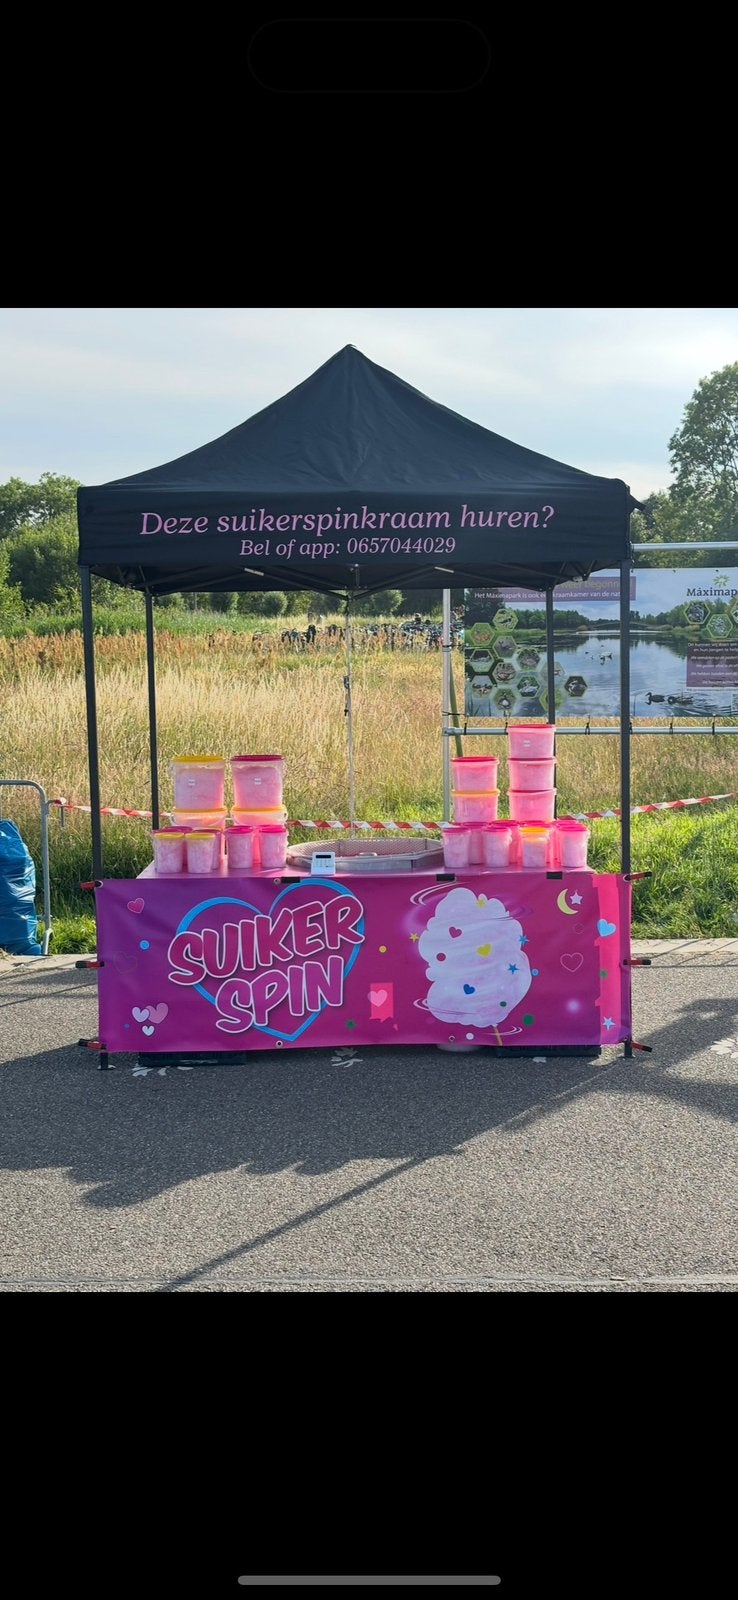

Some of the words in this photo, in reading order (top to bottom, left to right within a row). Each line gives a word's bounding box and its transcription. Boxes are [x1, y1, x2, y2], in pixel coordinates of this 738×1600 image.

[140, 512, 209, 535] Deze
[217, 505, 452, 537] suikerspinkraam
[460, 503, 555, 529] huren?
[239, 539, 270, 556] Bel
[275, 539, 296, 560] of
[299, 541, 341, 559] app:
[346, 537, 457, 554] 0657044029
[167, 894, 366, 986] SUIKER
[215, 955, 345, 1034] SPIN
